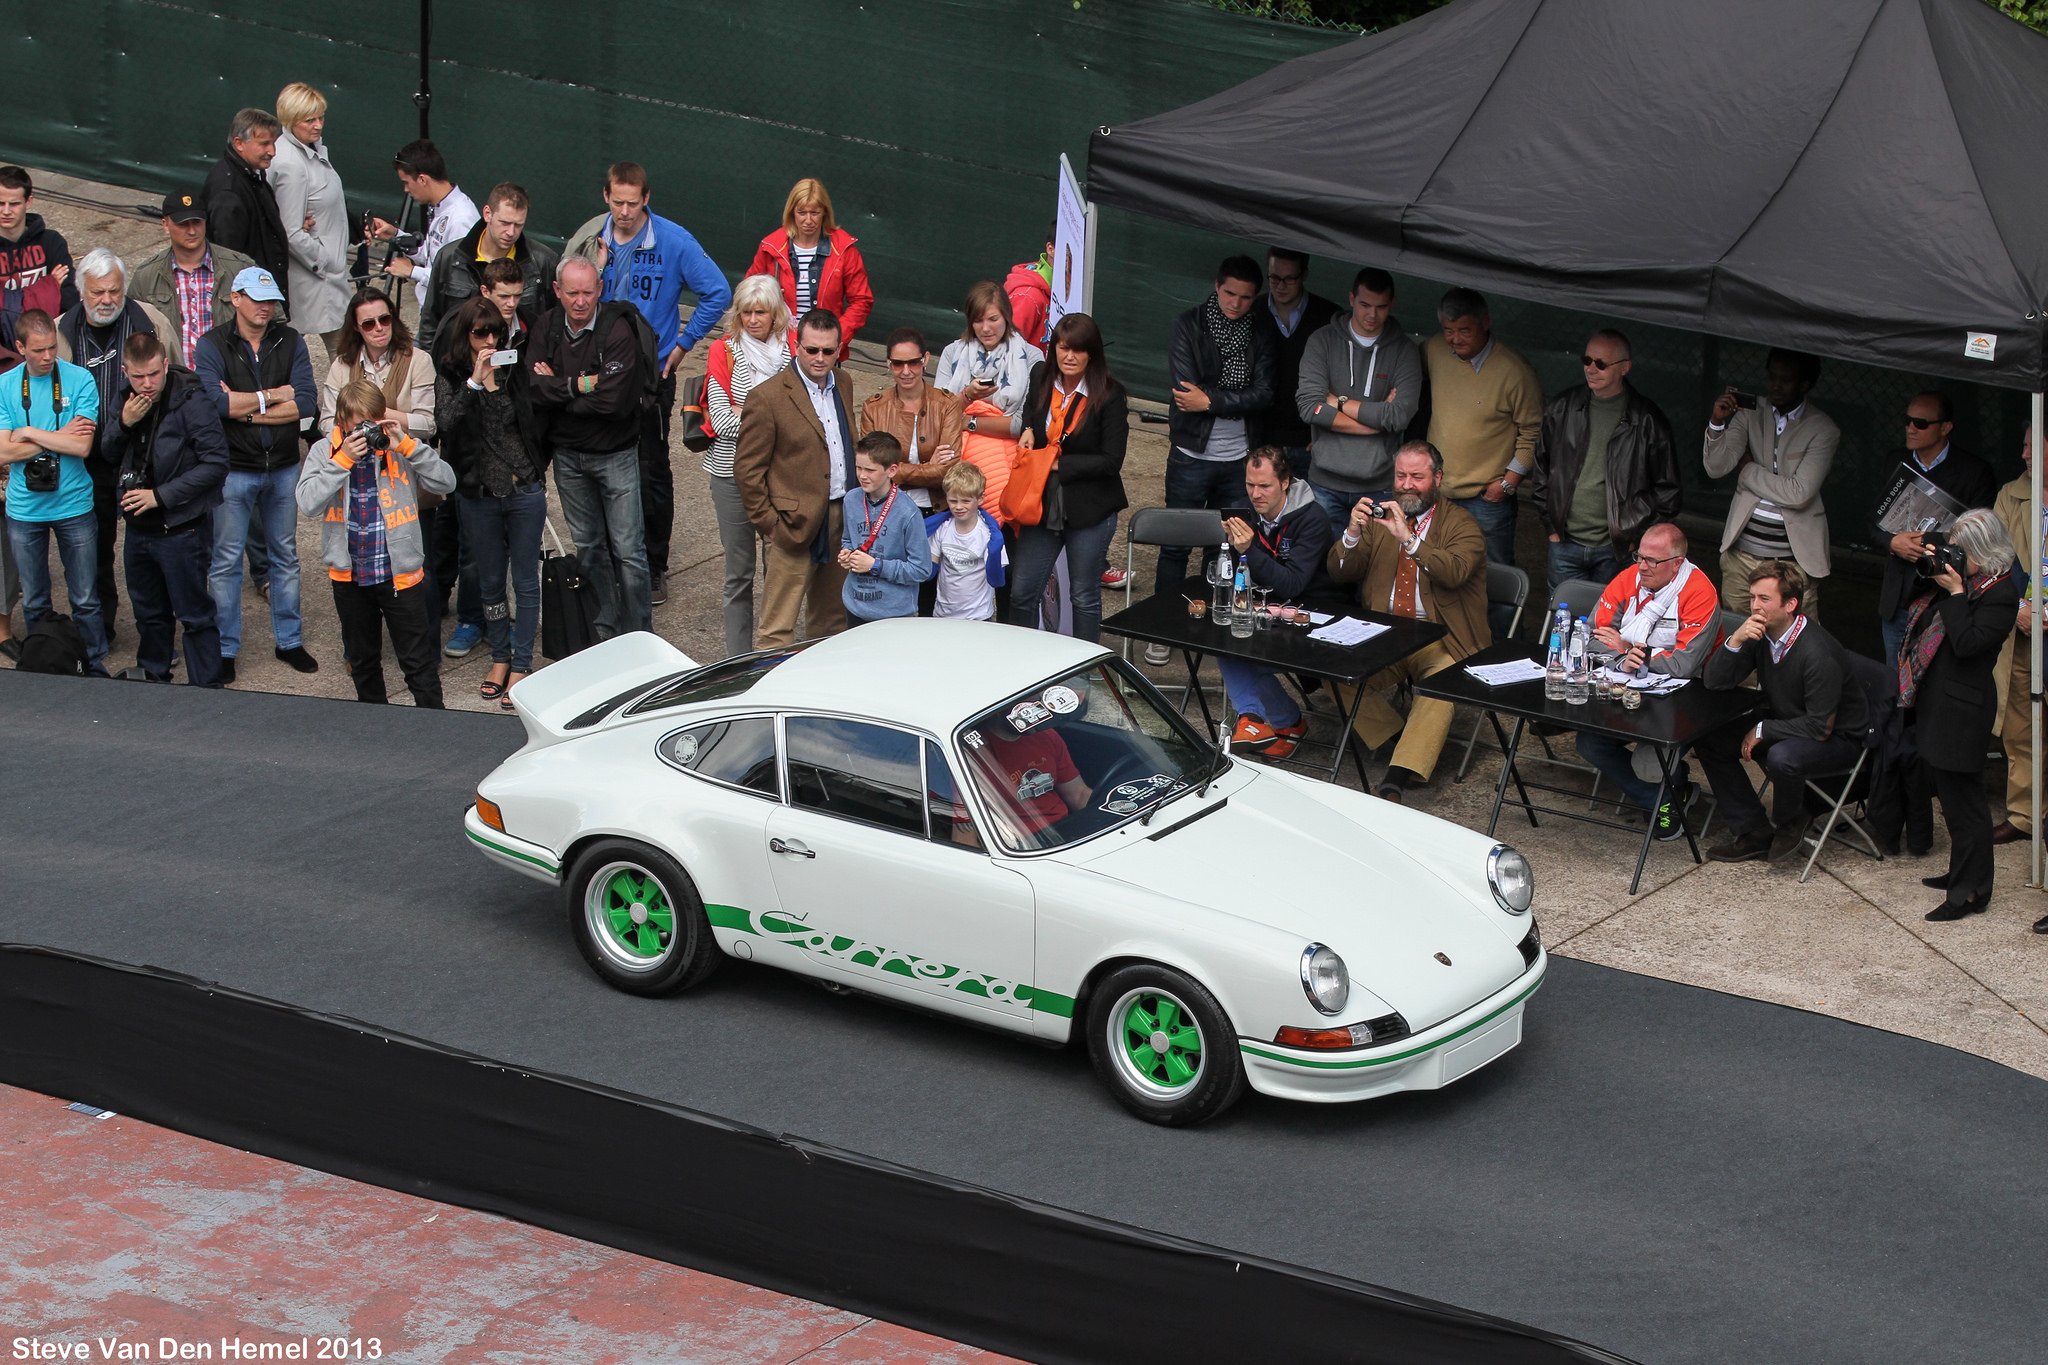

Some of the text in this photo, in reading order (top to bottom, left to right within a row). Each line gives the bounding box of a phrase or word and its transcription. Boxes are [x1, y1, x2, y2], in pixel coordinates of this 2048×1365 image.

[634, 253, 663, 266] STRA
[1876, 477, 1905, 516] ROAD BOOK
[872, 513, 885, 536] VANDER
[965, 731, 981, 744] BOX
[748, 910, 1034, 1010] Carrera
